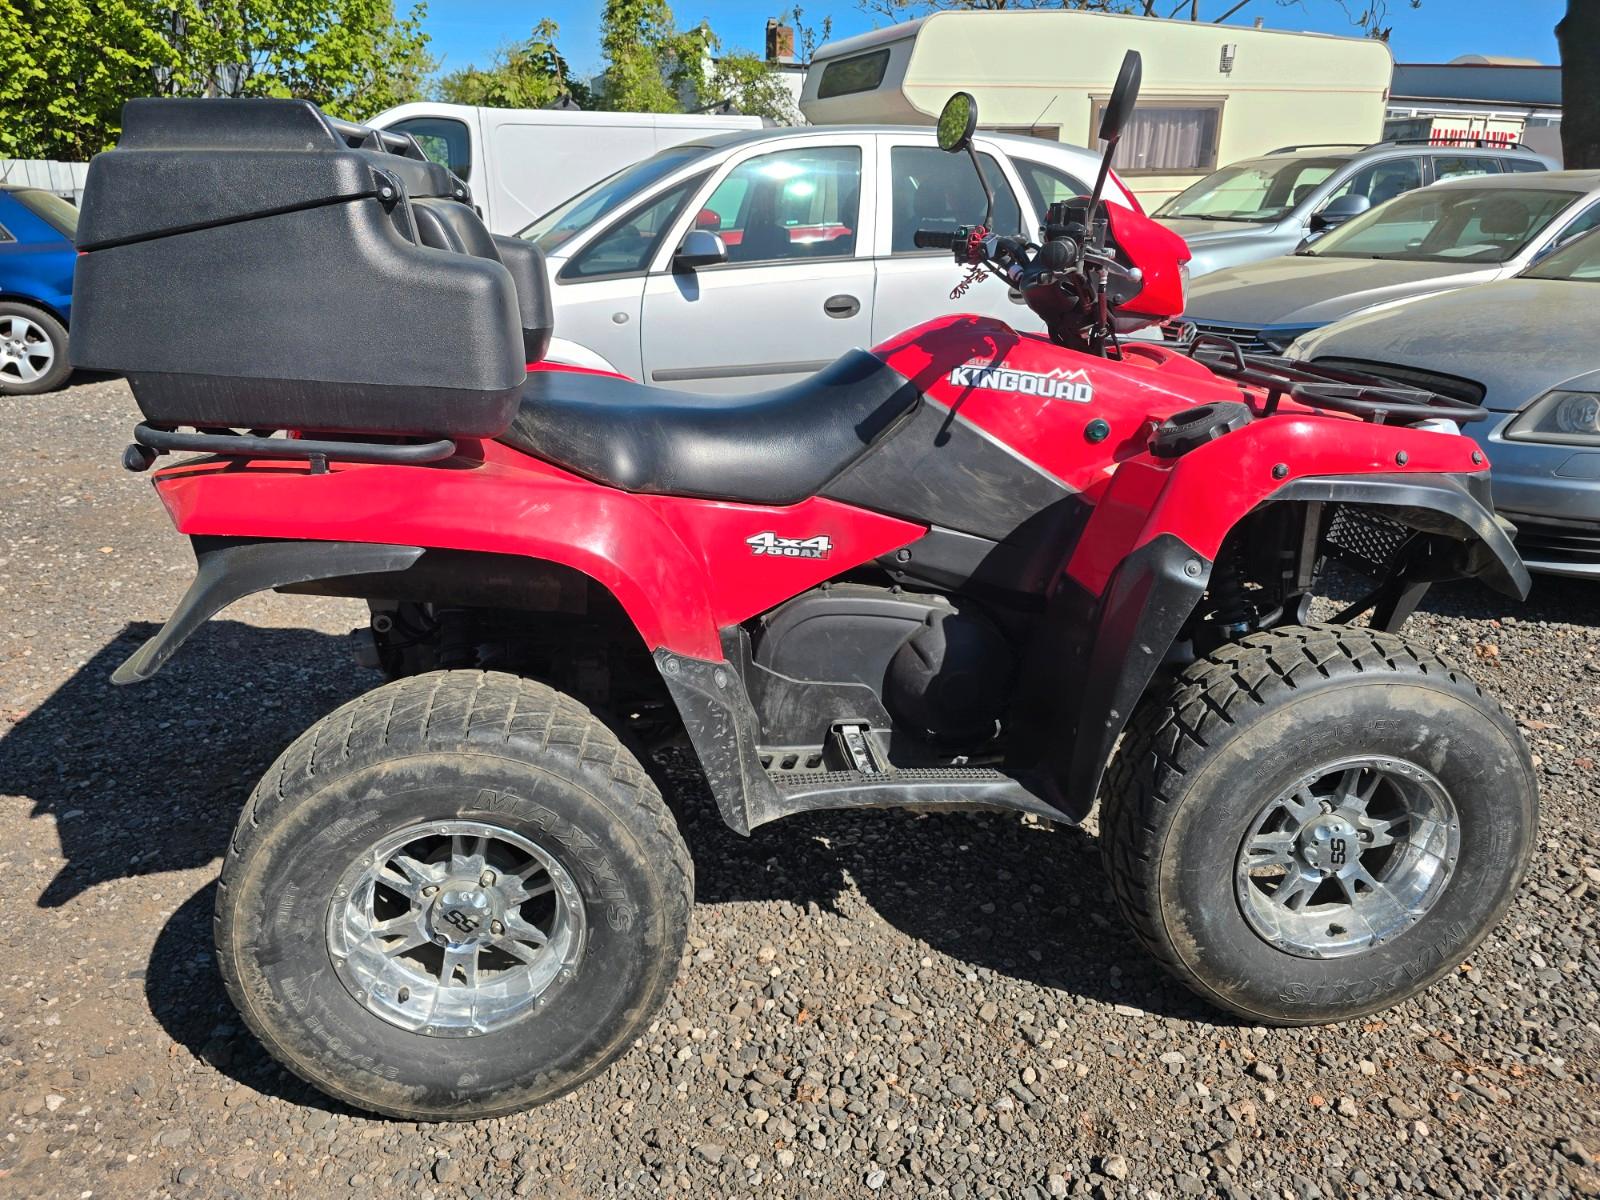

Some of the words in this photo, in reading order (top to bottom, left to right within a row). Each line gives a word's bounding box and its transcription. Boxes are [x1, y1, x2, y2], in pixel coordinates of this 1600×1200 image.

[950, 367, 1094, 403] KINGQUAD
[472, 788, 634, 935] MAXXIS
[1277, 920, 1470, 1005] MAXXIS
